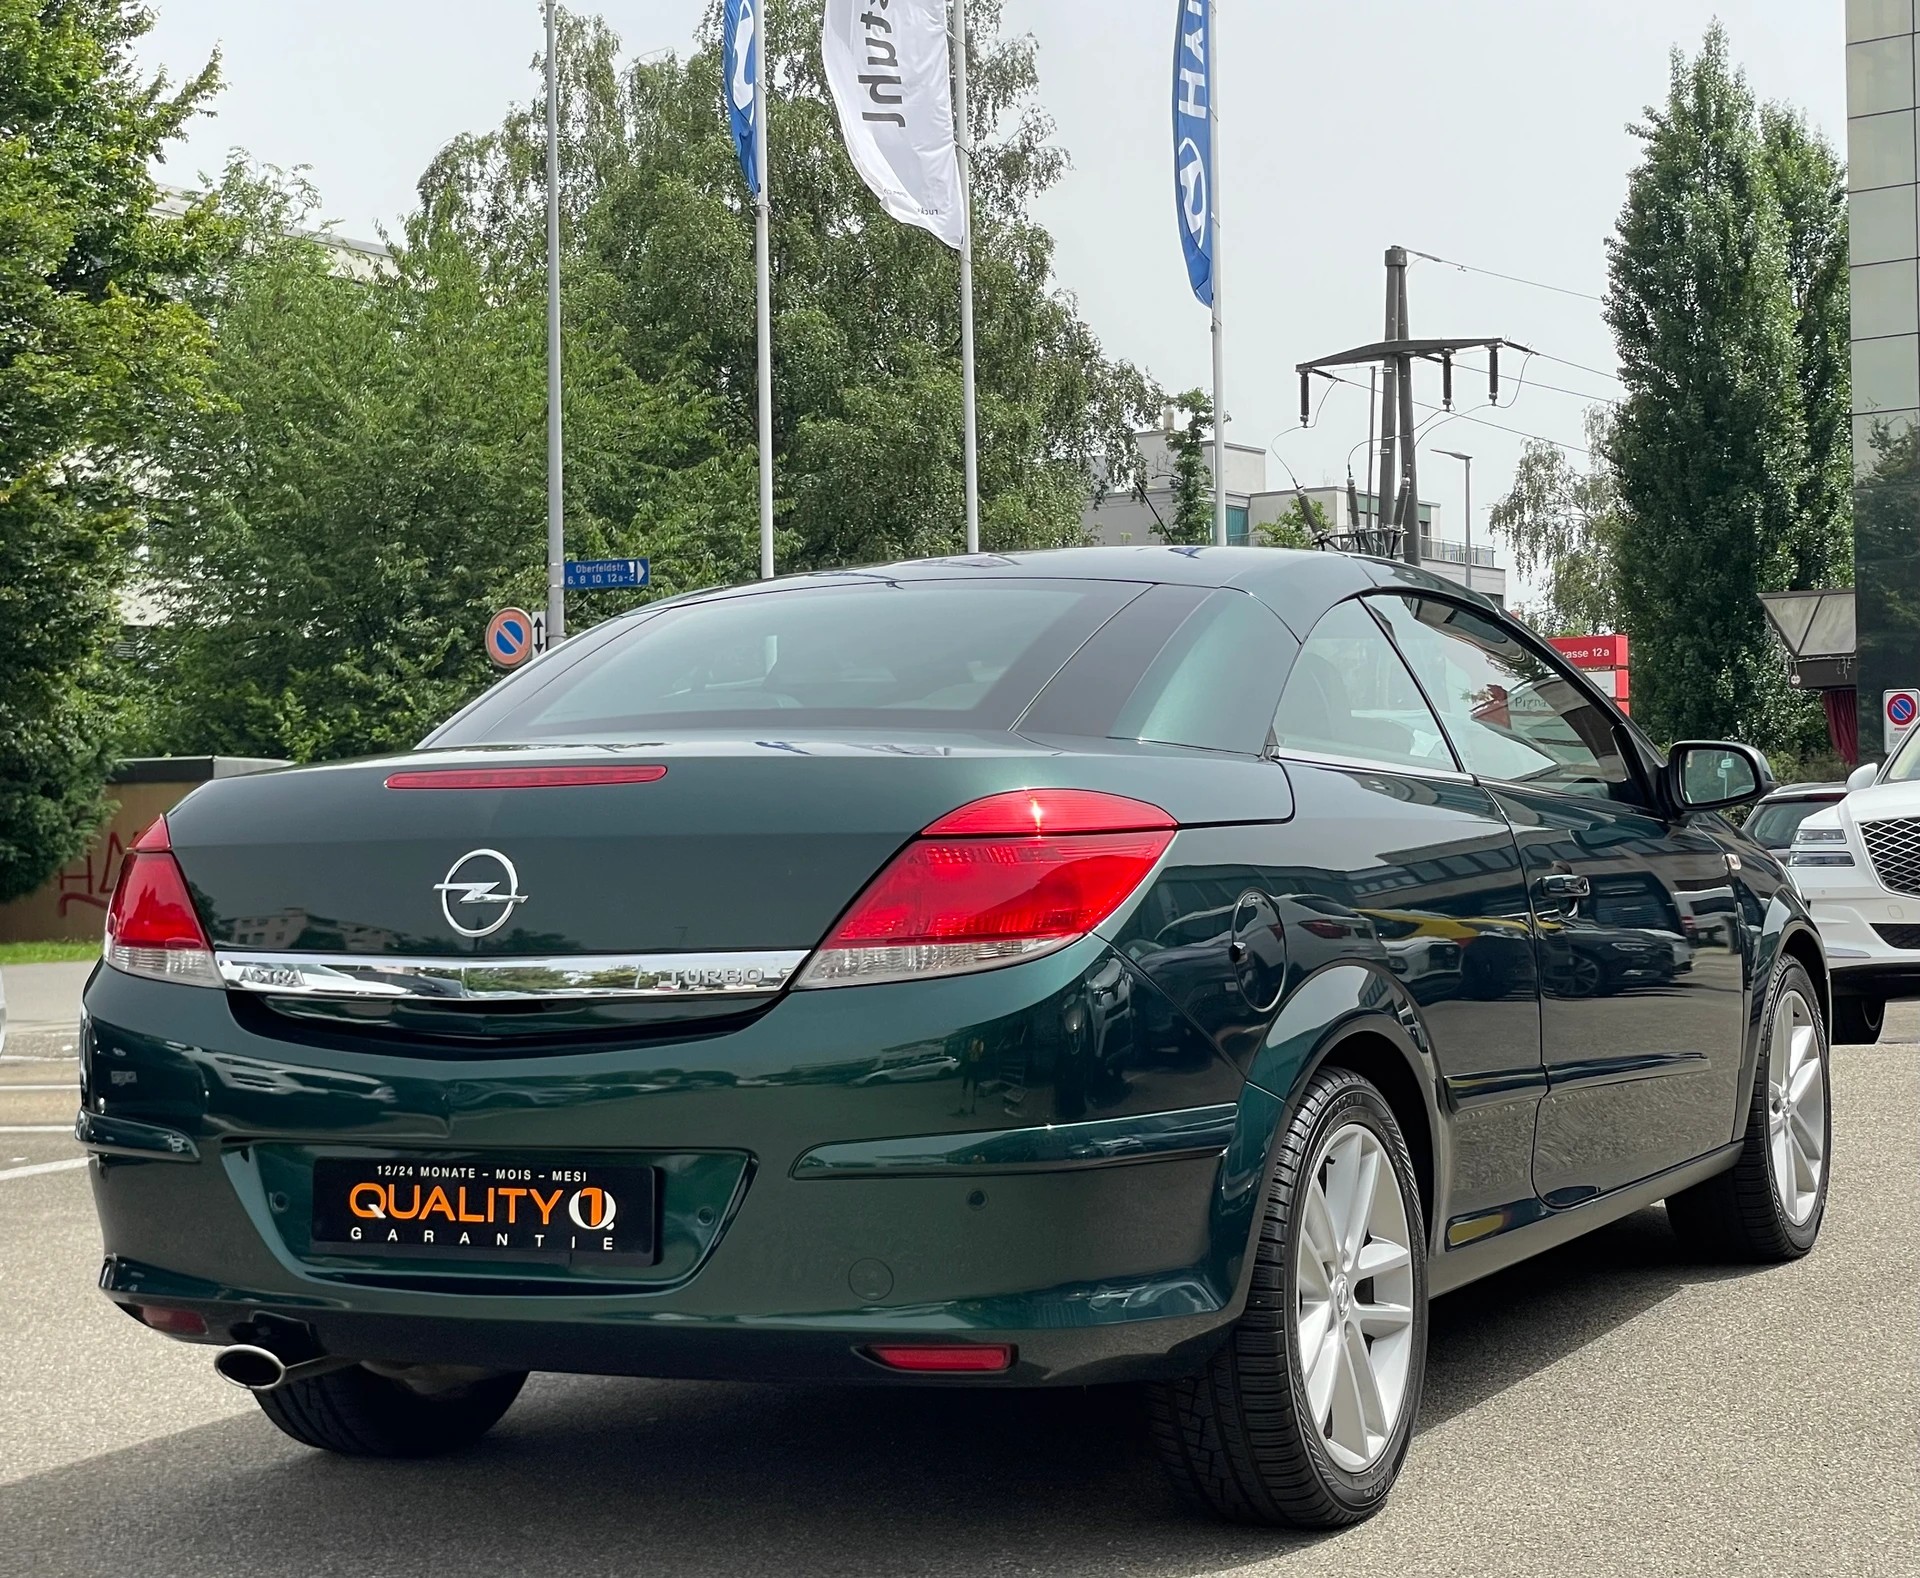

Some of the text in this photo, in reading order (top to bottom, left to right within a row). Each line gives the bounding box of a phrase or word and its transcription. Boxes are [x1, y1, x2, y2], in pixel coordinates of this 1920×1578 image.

[576, 563, 626, 574] Oberfeldstr.
[239, 967, 306, 986] ASTRA
[667, 967, 765, 986] TURBO
[377, 1165, 413, 1176] 12/24
[420, 1166, 476, 1178] MONATE
[496, 1169, 531, 1180] MOIS
[552, 1170, 587, 1182] MESI
[350, 1183, 564, 1225] QUALITY
[350, 1226, 614, 1250] GARANTIE
